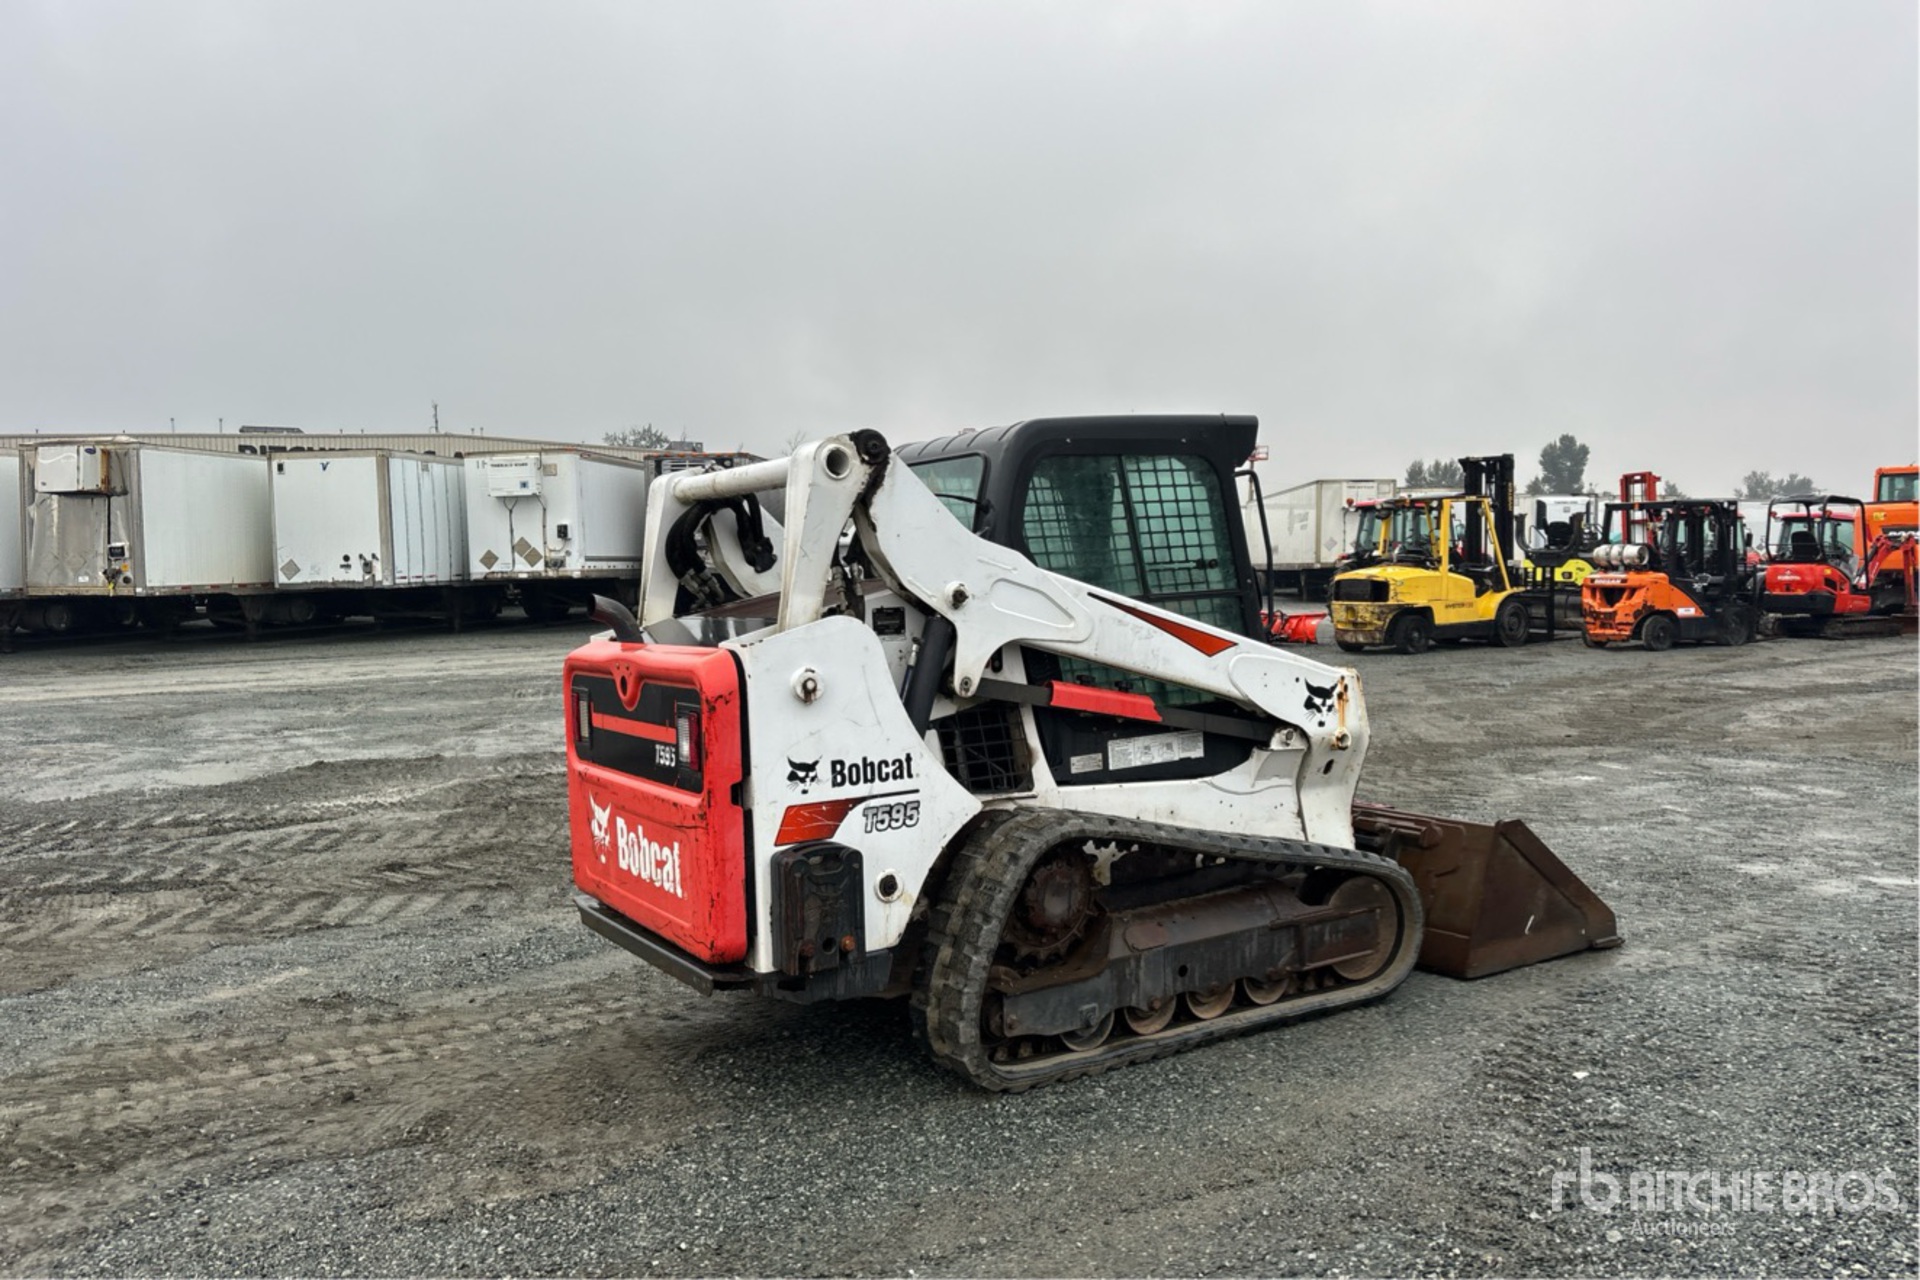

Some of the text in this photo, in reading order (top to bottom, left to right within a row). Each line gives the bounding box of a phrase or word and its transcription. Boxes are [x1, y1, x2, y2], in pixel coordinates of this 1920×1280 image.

[655, 744, 676, 767] T595
[831, 752, 914, 788] Bobcat
[862, 800, 920, 834] T595
[616, 816, 682, 899] Bobcat
